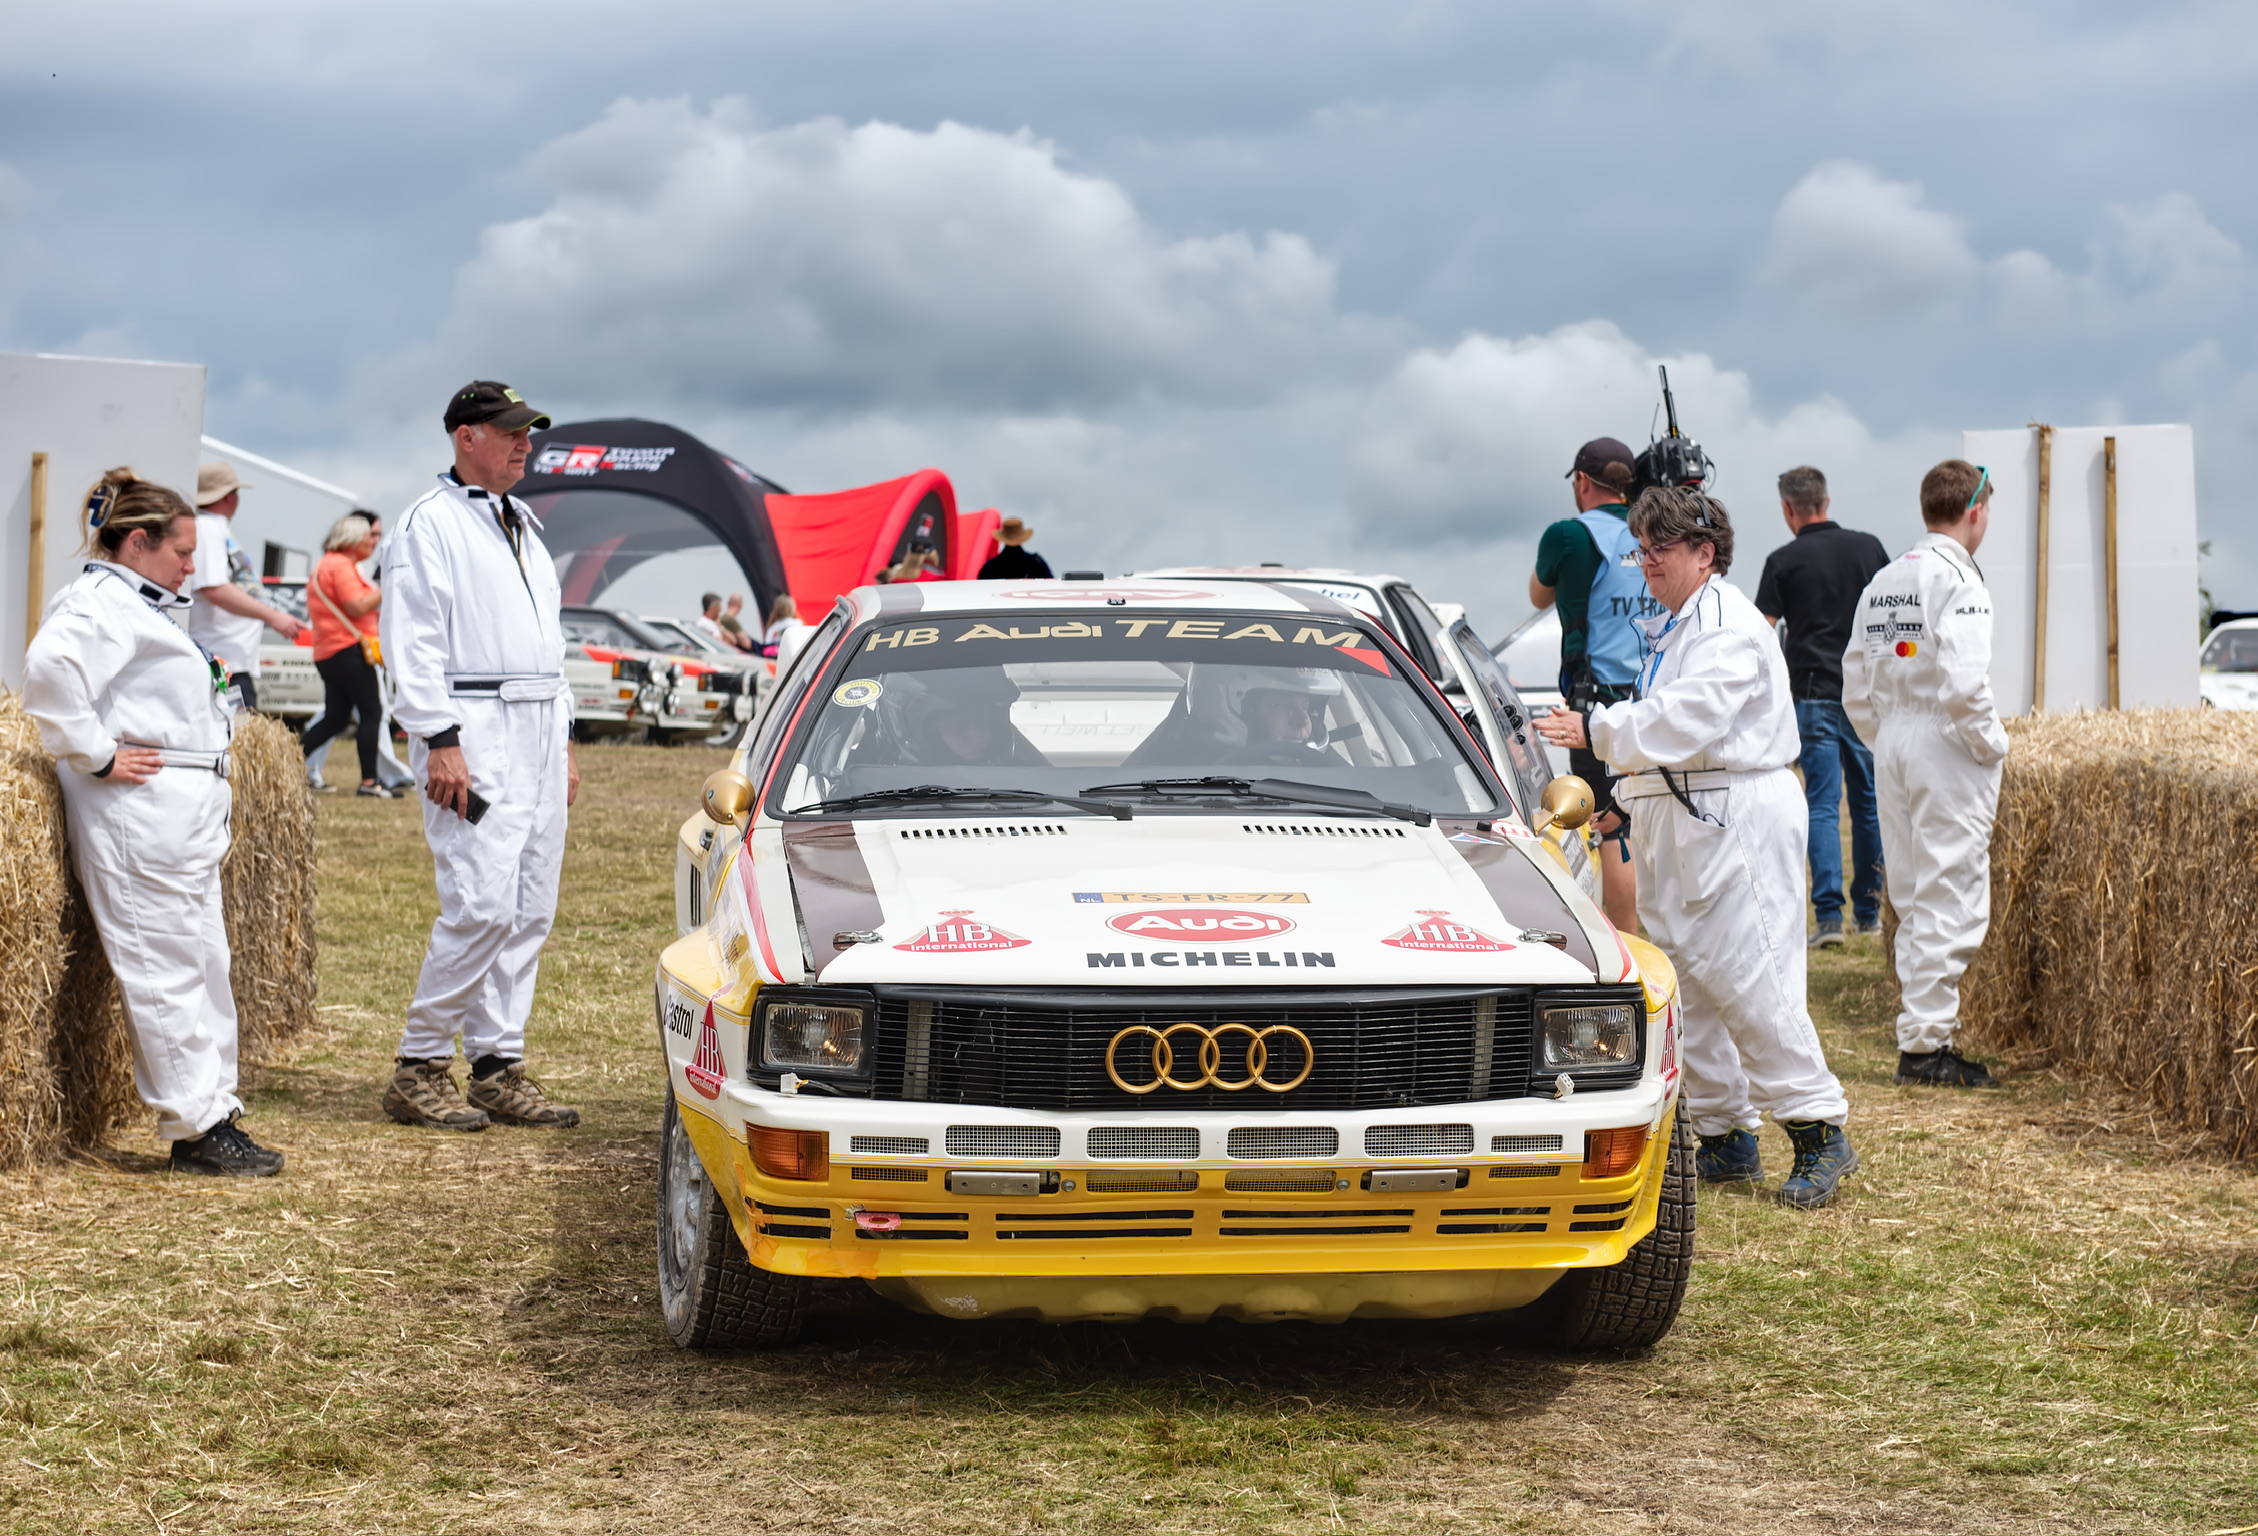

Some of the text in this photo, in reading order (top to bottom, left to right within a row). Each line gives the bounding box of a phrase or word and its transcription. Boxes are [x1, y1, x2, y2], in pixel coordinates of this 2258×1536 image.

[540, 449, 601, 468] GR
[1610, 597, 1633, 616] TV
[1868, 593, 1921, 609] MARSHAL
[865, 626, 940, 651] HB
[1115, 619, 1364, 648] TEAM
[1113, 894, 1294, 902] TS-FR-77
[1125, 915, 1282, 931] Audi
[926, 924, 994, 943] HB
[1409, 924, 1479, 942] HB
[1086, 952, 1336, 968] MICHELIN
[663, 995, 694, 1040] Castrol
[700, 1022, 720, 1077] HB
